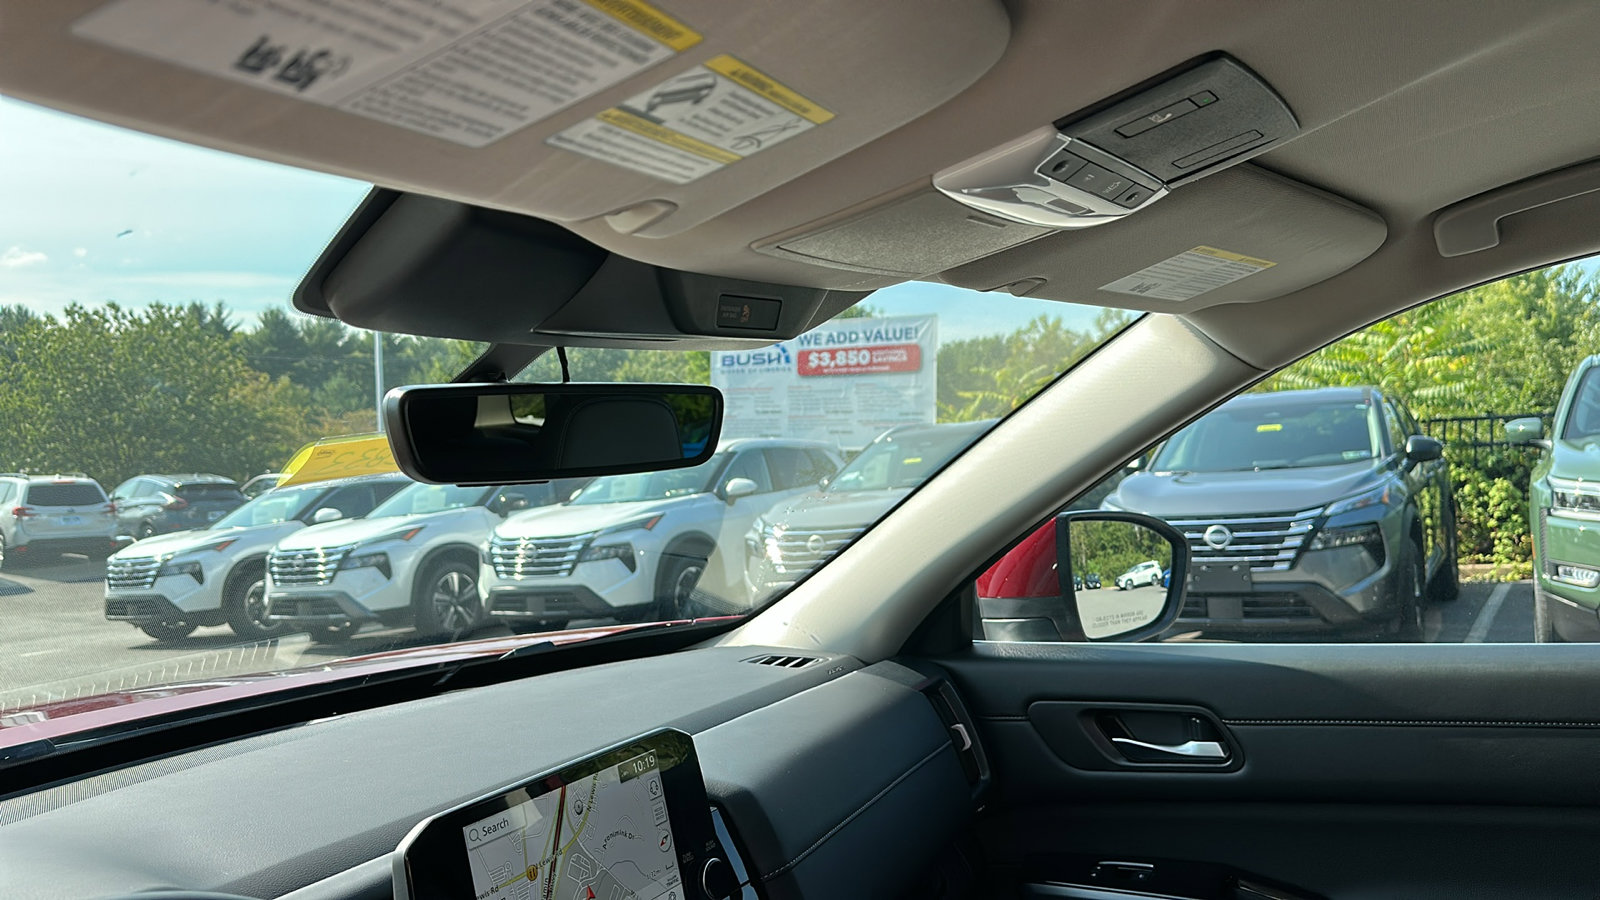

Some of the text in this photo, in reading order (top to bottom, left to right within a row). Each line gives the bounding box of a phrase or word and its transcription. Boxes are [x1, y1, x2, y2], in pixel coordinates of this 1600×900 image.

[800, 326, 919, 347] WE ADD VALUE!
[722, 351, 781, 367] BUSH
[808, 349, 871, 368] $3,850
[632, 755, 656, 773] 10:19
[482, 818, 509, 836] Search
[491, 884, 500, 895] Rd
